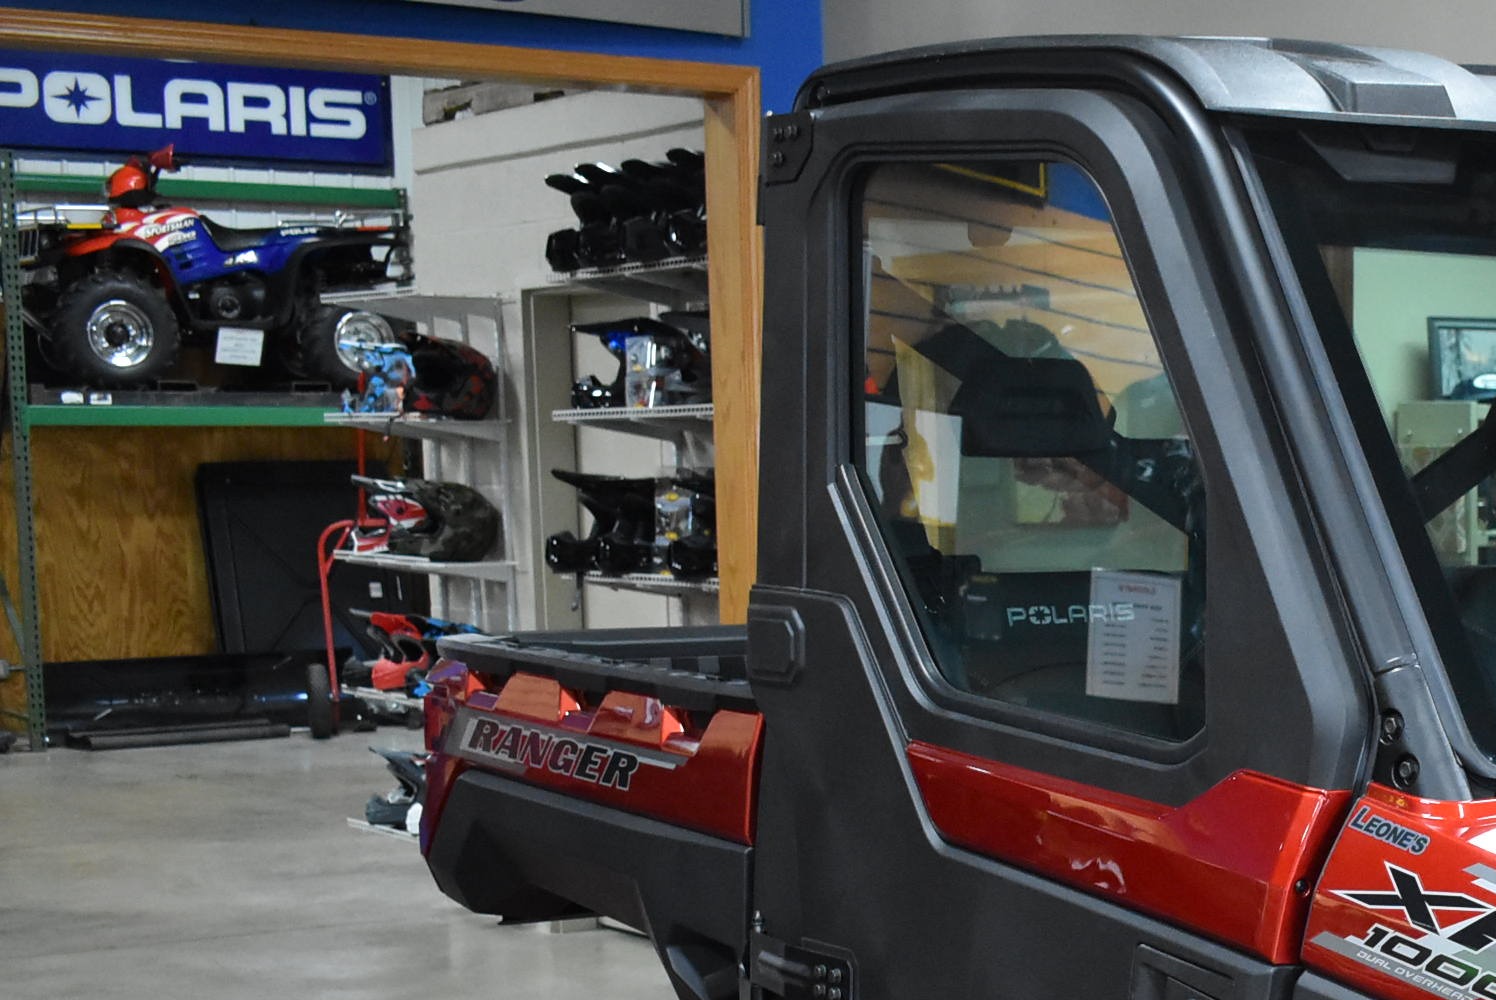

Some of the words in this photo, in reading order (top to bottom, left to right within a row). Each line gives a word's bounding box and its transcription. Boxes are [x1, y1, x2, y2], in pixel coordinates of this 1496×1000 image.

[1006, 603, 1135, 627] POLARIS
[468, 716, 639, 791] RANGER
[1350, 805, 1430, 854] LEONE'S
[1356, 951, 1392, 971] DUAL
